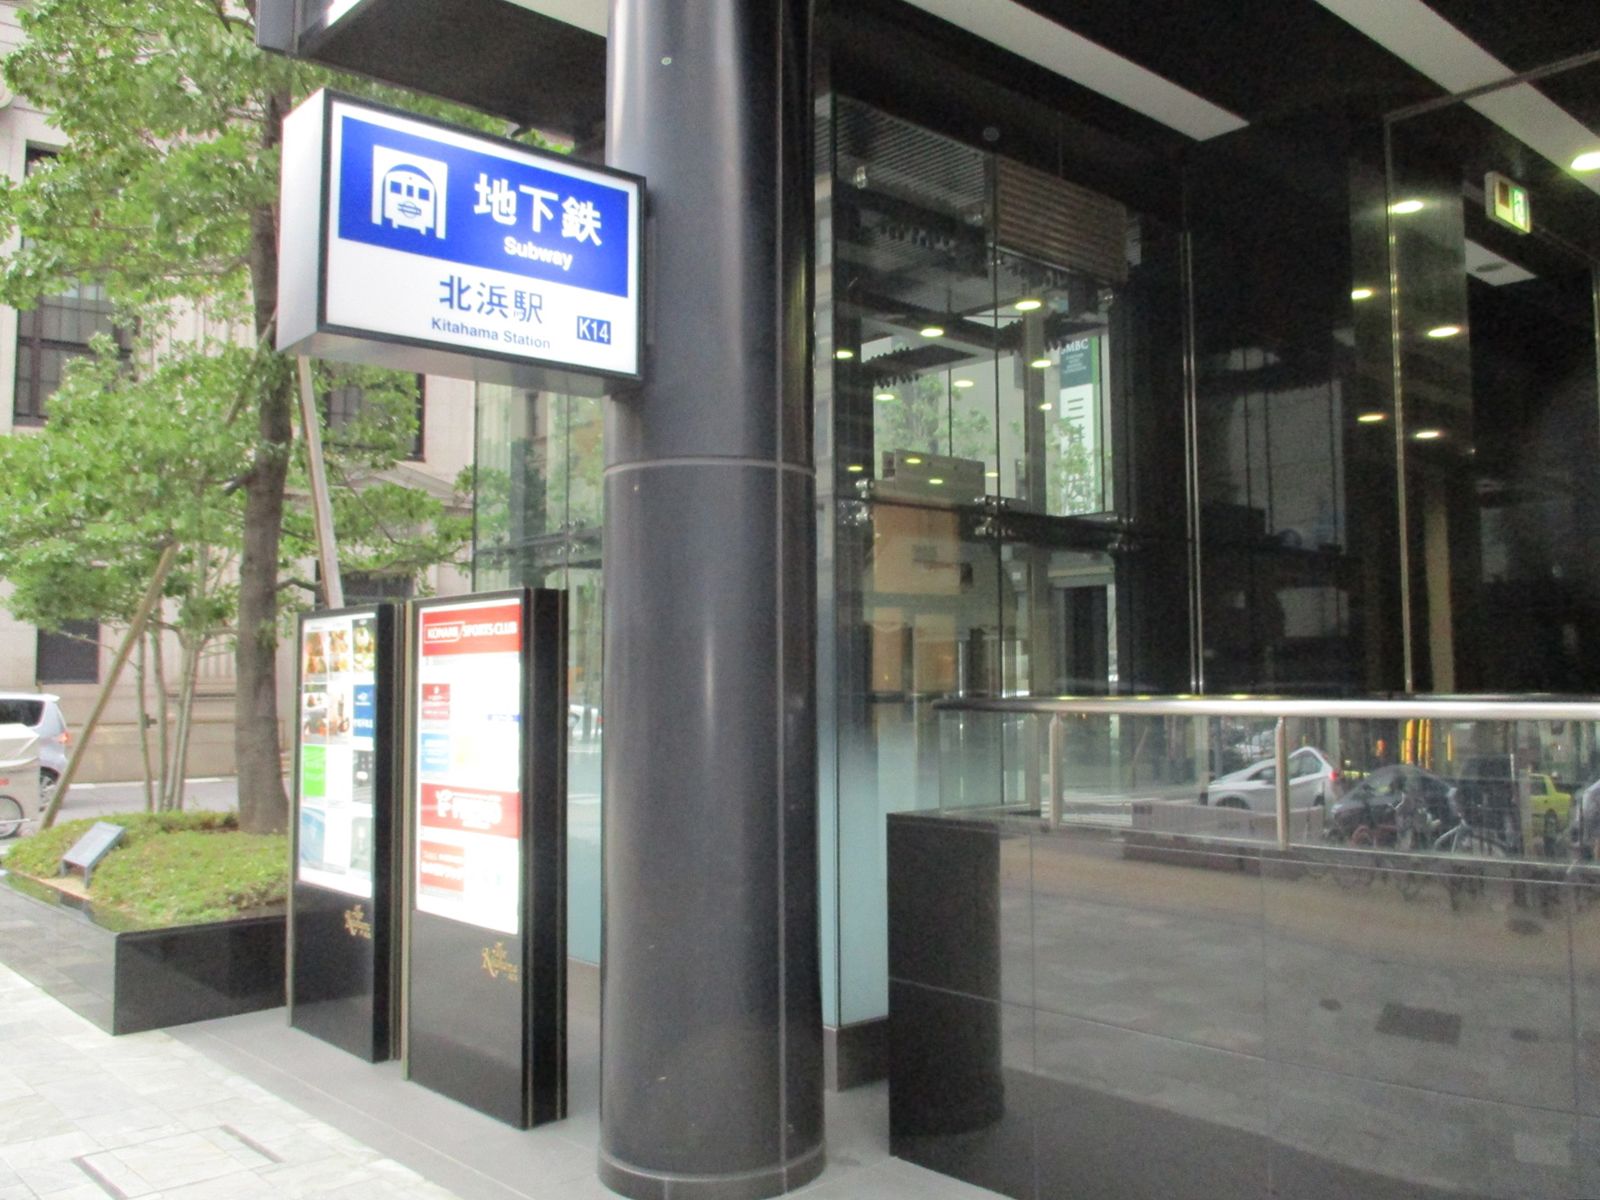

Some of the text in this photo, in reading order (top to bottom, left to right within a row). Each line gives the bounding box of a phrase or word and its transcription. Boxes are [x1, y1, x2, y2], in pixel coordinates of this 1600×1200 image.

[474, 172, 603, 247] 地下鉄
[503, 236, 573, 271] Subway
[439, 275, 543, 324] 北浜駅
[431, 316, 551, 349] Kitahama Station
[578, 316, 610, 344] K14
